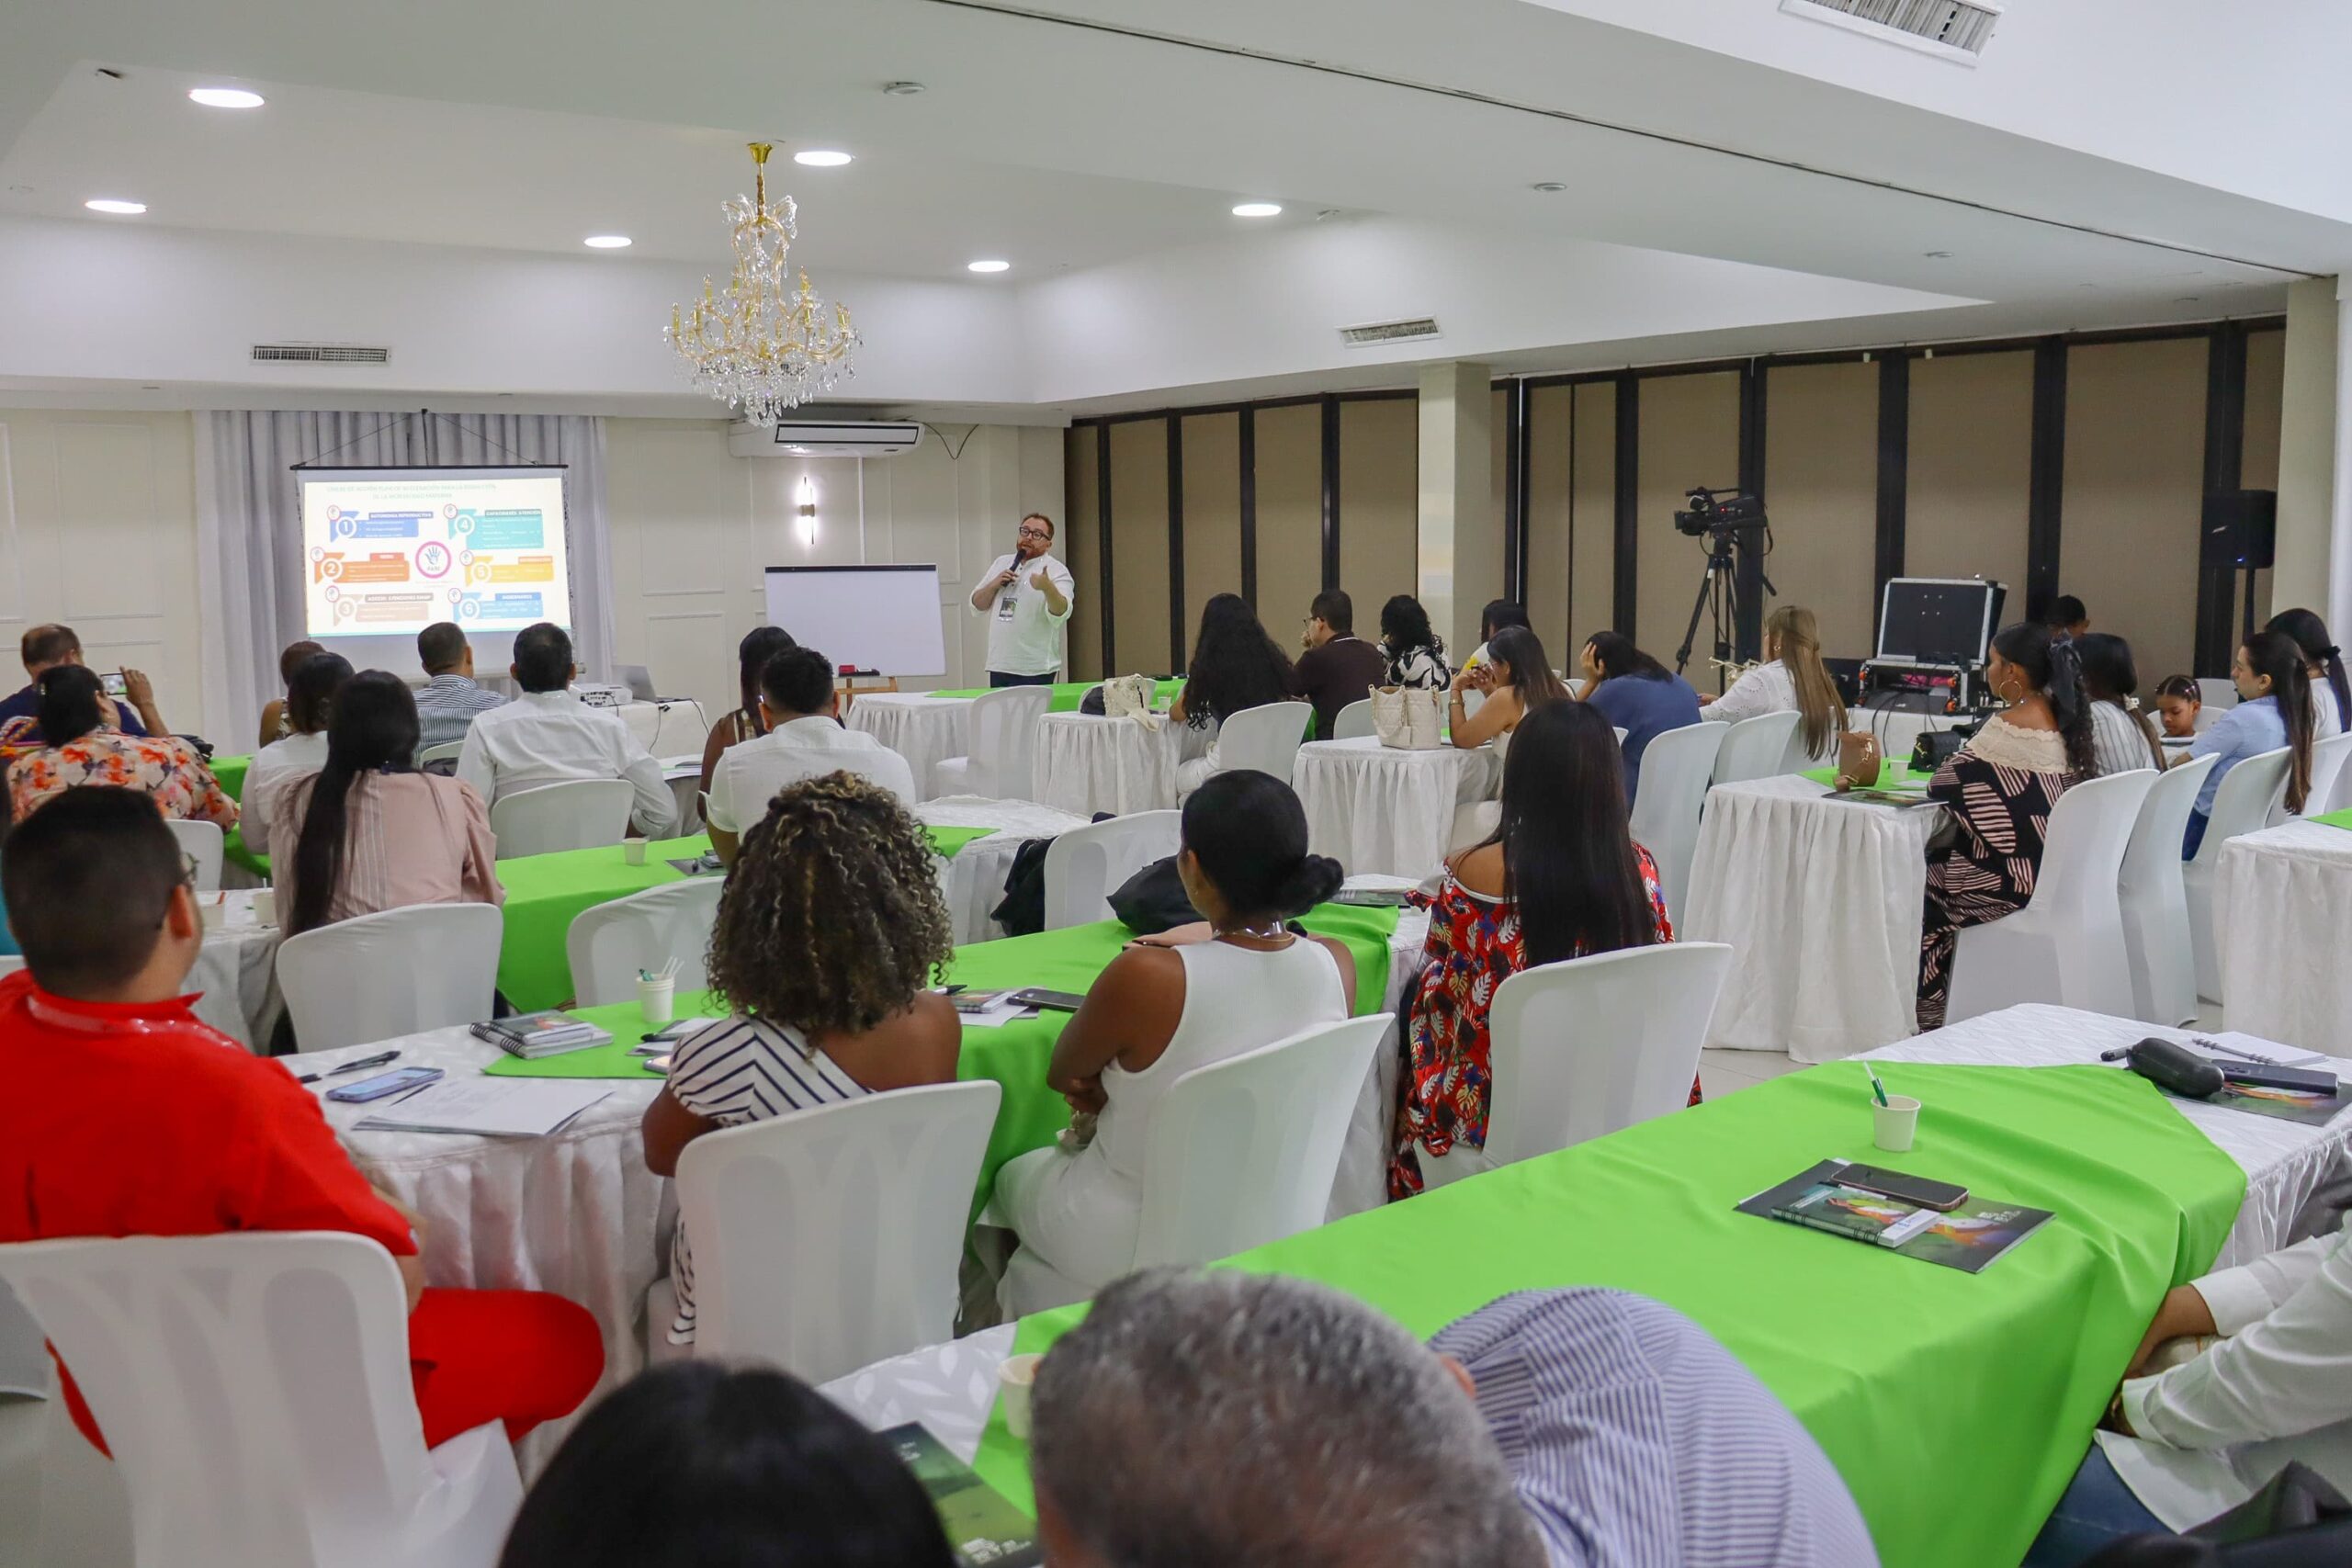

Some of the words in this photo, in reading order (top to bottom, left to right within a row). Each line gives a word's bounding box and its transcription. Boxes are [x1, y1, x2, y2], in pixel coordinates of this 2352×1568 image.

[343, 521, 348, 532] 1
[460, 521, 469, 531] 4
[327, 564, 336, 574] 2
[342, 604, 350, 615] 3
[465, 604, 473, 615] 6
